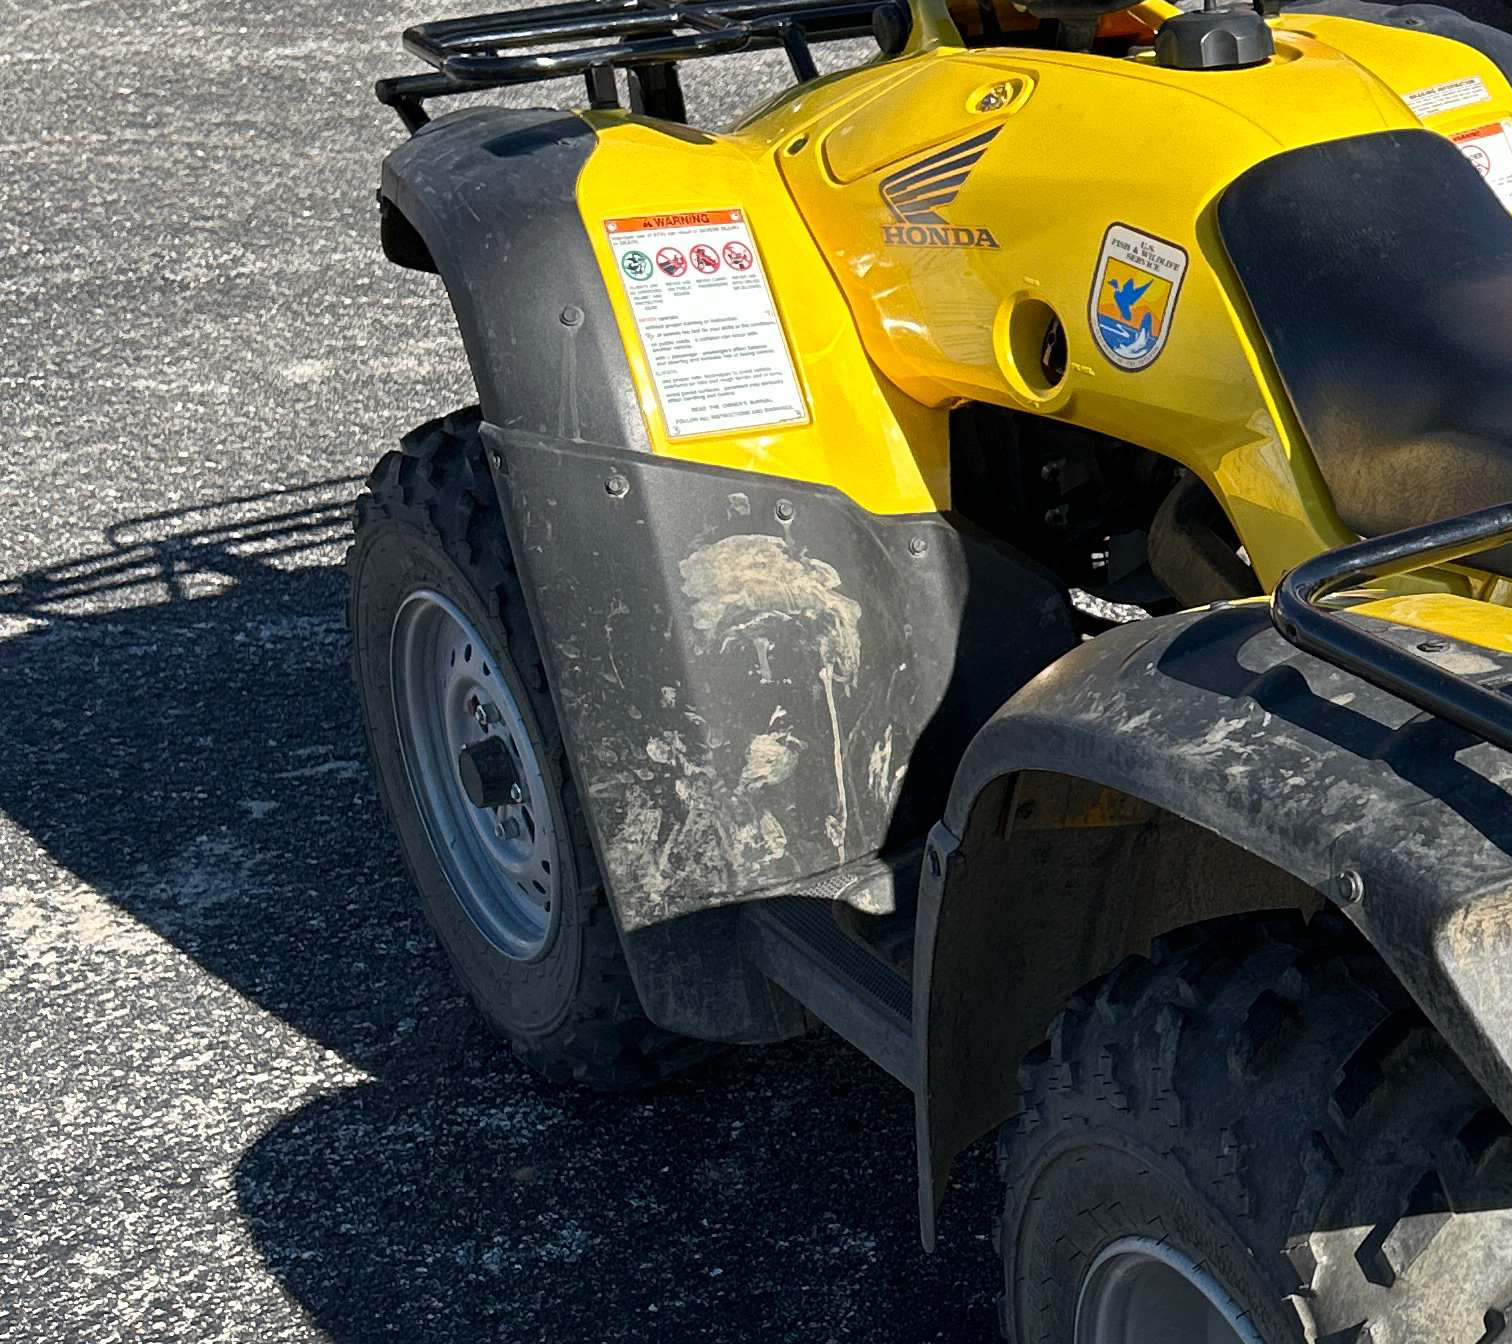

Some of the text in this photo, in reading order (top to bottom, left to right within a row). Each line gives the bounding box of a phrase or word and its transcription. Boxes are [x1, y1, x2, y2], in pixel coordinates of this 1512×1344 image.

[653, 213, 709, 226] WARNING
[881, 225, 1001, 249] HONDA
[1111, 238, 1130, 251] FISH
[1140, 250, 1180, 271] WILDLIFE
[1126, 253, 1160, 271] SERVICE
